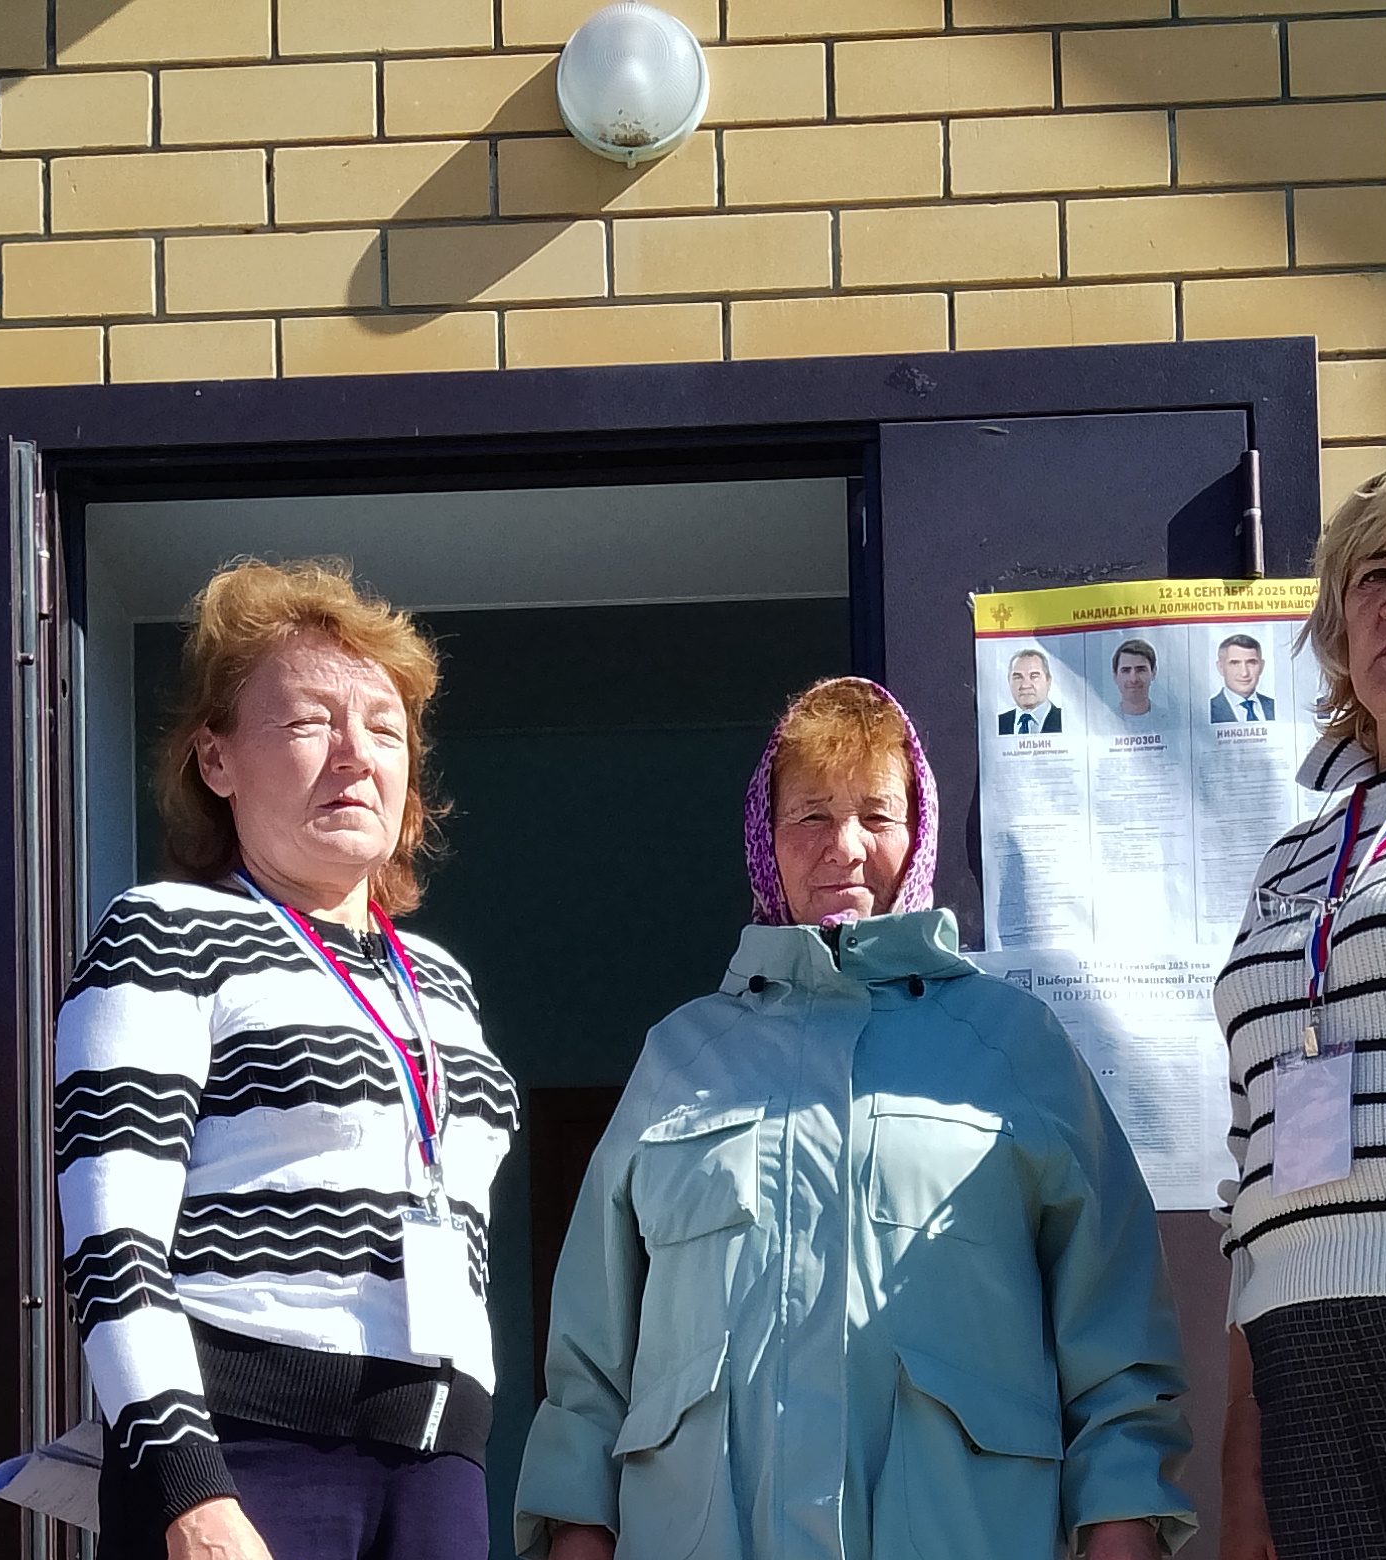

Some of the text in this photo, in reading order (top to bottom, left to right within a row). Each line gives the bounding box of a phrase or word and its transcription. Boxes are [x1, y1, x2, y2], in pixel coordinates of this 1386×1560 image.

[1158, 585, 1319, 598] 12-14 СЕНТЯБРЯ 2025 ГОДА
[1073, 607, 1138, 621] КАНДИДАТЫ
[1142, 605, 1156, 614] НА
[1159, 601, 1224, 615] ДОЛЖНОСТЬ
[1227, 600, 1264, 611] ГЛАВЫ
[1217, 727, 1268, 739] НИКОЛАЕВ
[1019, 740, 1051, 749] ИЛЬИН
[1115, 735, 1161, 746] МОРОЗОВ
[1168, 961, 1188, 970] 2025
[1037, 974, 1082, 987] Выборы
[1053, 989, 1117, 1002] ПОРЯДО
